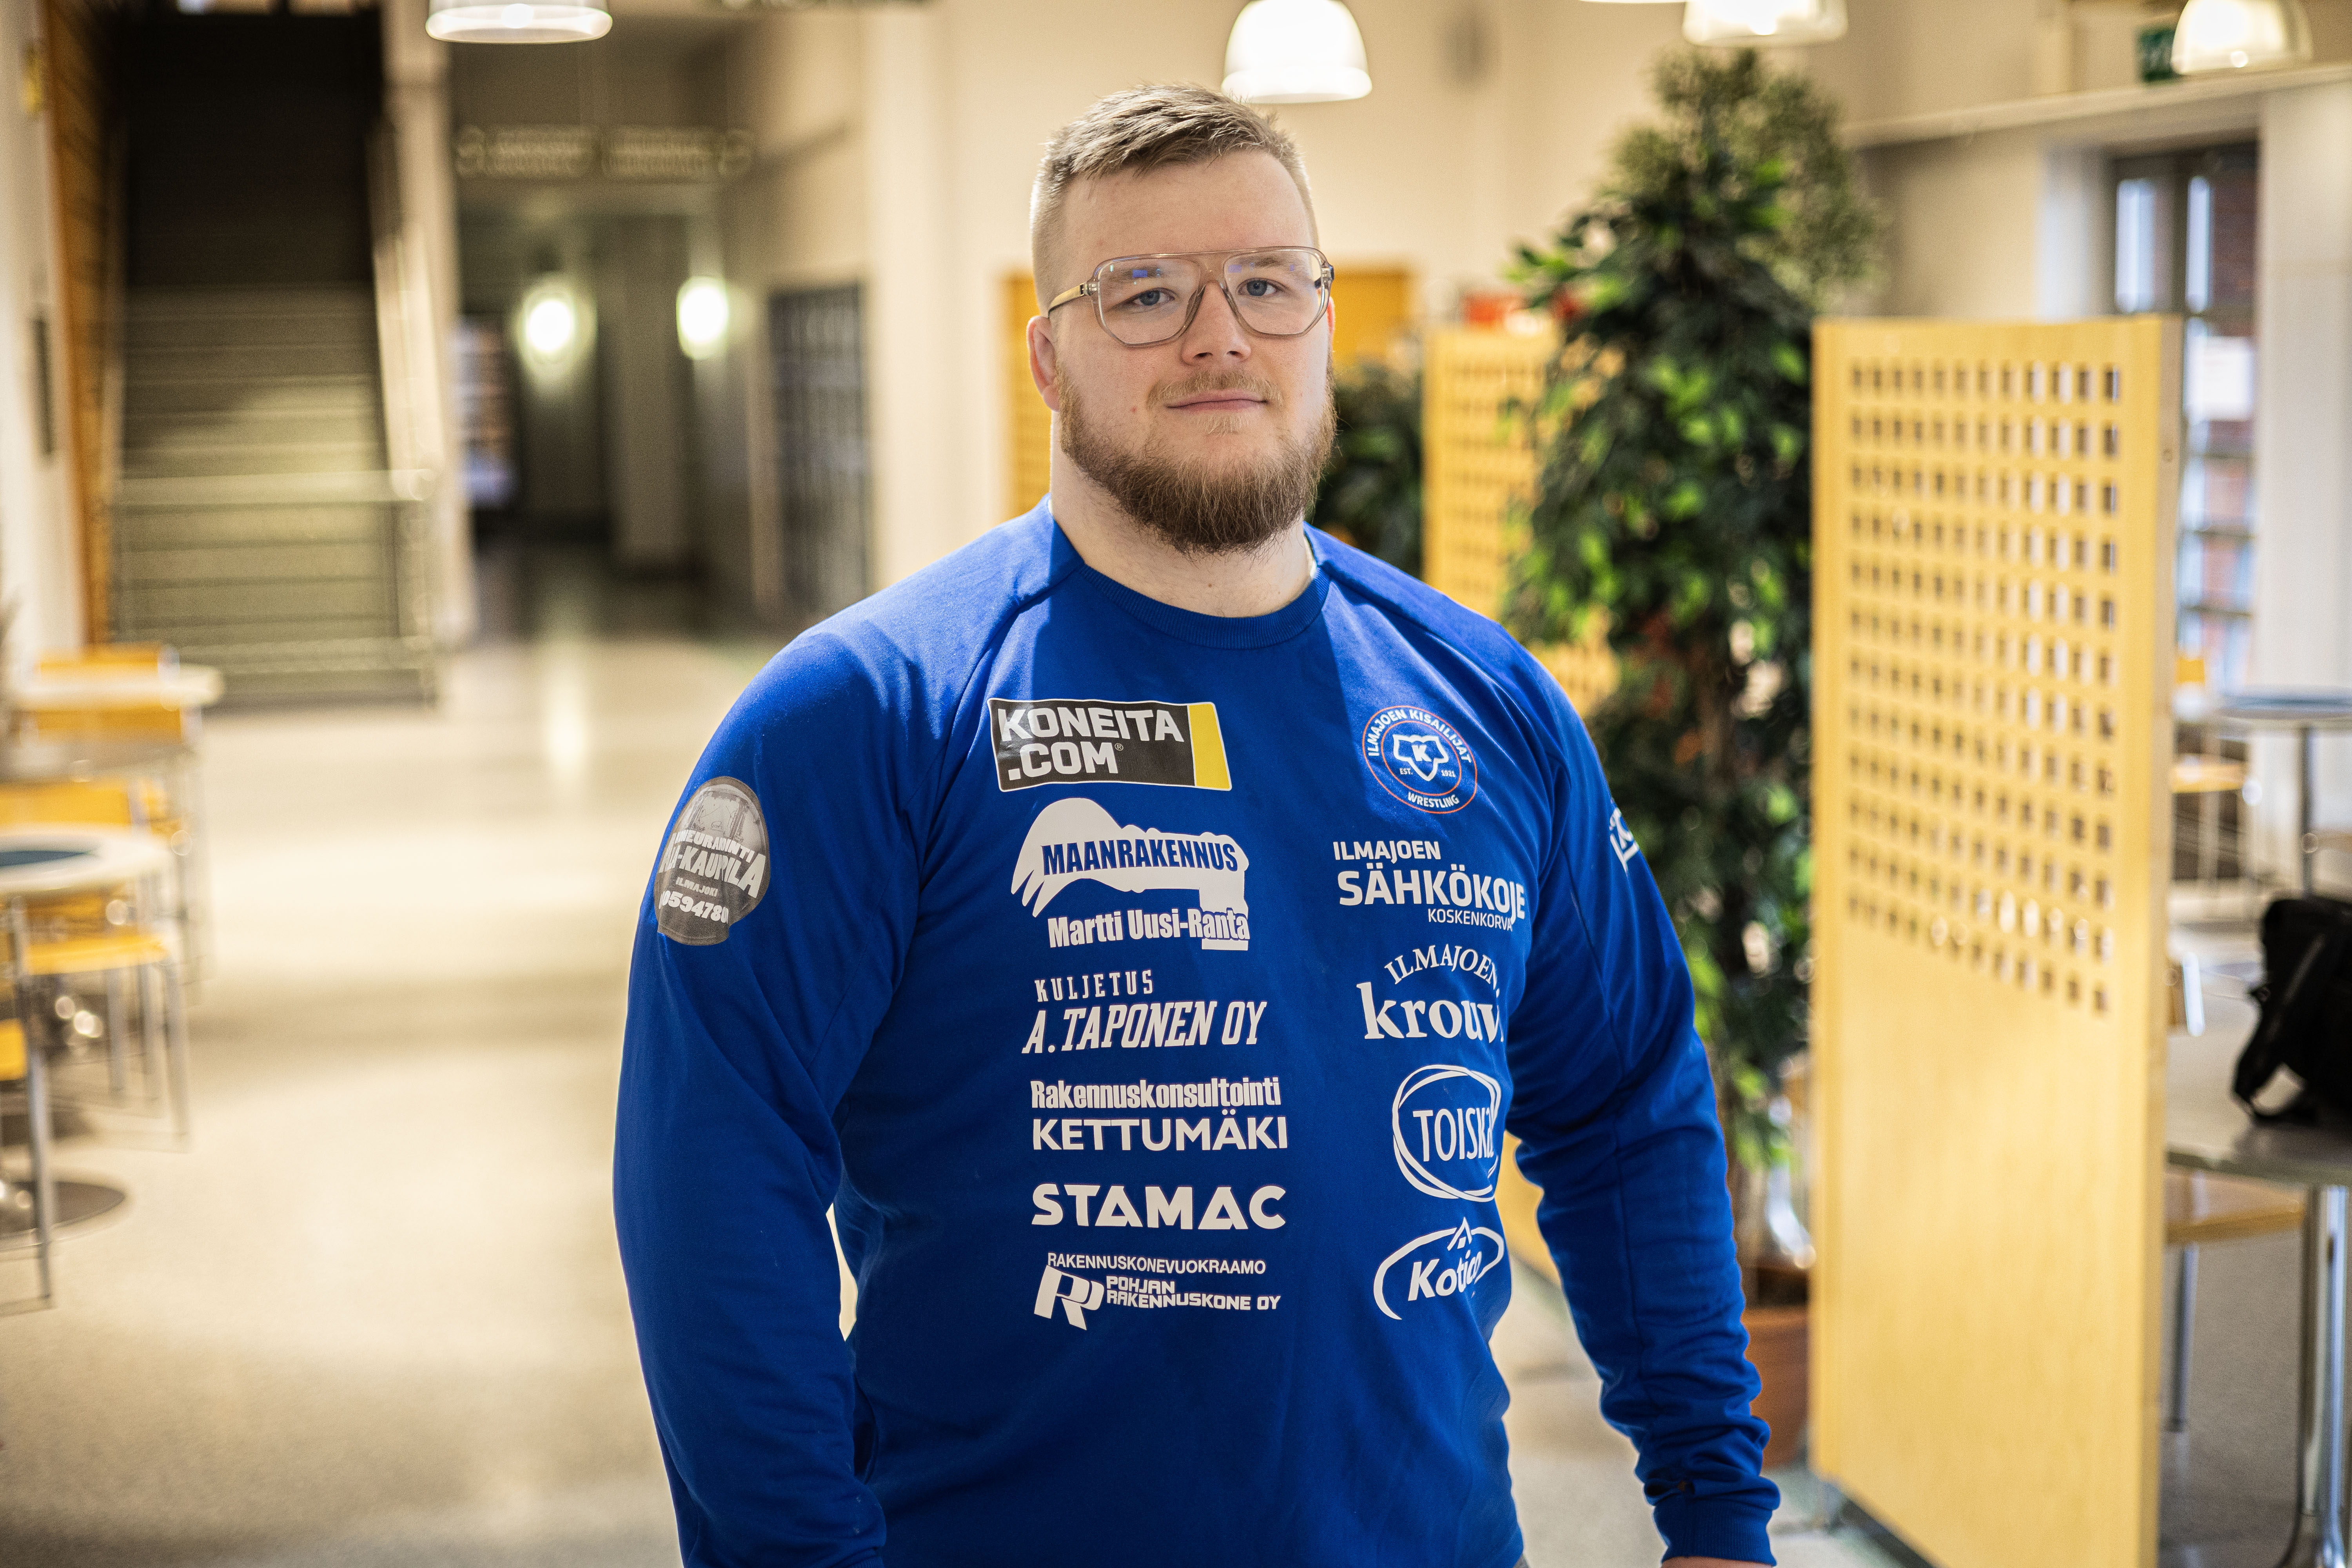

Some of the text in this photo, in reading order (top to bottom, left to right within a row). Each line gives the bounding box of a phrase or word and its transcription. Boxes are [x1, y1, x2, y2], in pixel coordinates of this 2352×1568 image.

[998, 707, 1184, 742] KONEITA
[1367, 709, 1472, 763] ILMAJOEN KISAILIJAT
[1408, 792, 1460, 808] WRESTLING
[1041, 838, 1238, 876] MAANRAKENNUS
[1333, 840, 1441, 864] ILMAJOEN
[675, 877, 719, 897] ILMAJOKI
[1337, 863, 1525, 926] SÄHKÖKOJE
[1048, 907, 1250, 948] Martti Uusi-Ranta
[1428, 908, 1513, 932] KOSKENKORVA
[1034, 969, 1154, 1002] KULJETUS
[1221, 1001, 1267, 1045] OY
[1030, 1077, 1282, 1109] Rakennuskonsultointi
[1032, 1109, 1288, 1151] KETTUMÄKI
[1031, 1183, 1286, 1230] STAMAC
[1048, 1252, 1266, 1274] RAKENNUSKONEVUOKRAAMO
[1106, 1276, 1176, 1294] POHJAN
[1106, 1289, 1281, 1310] RAKENNUSKONE OY
